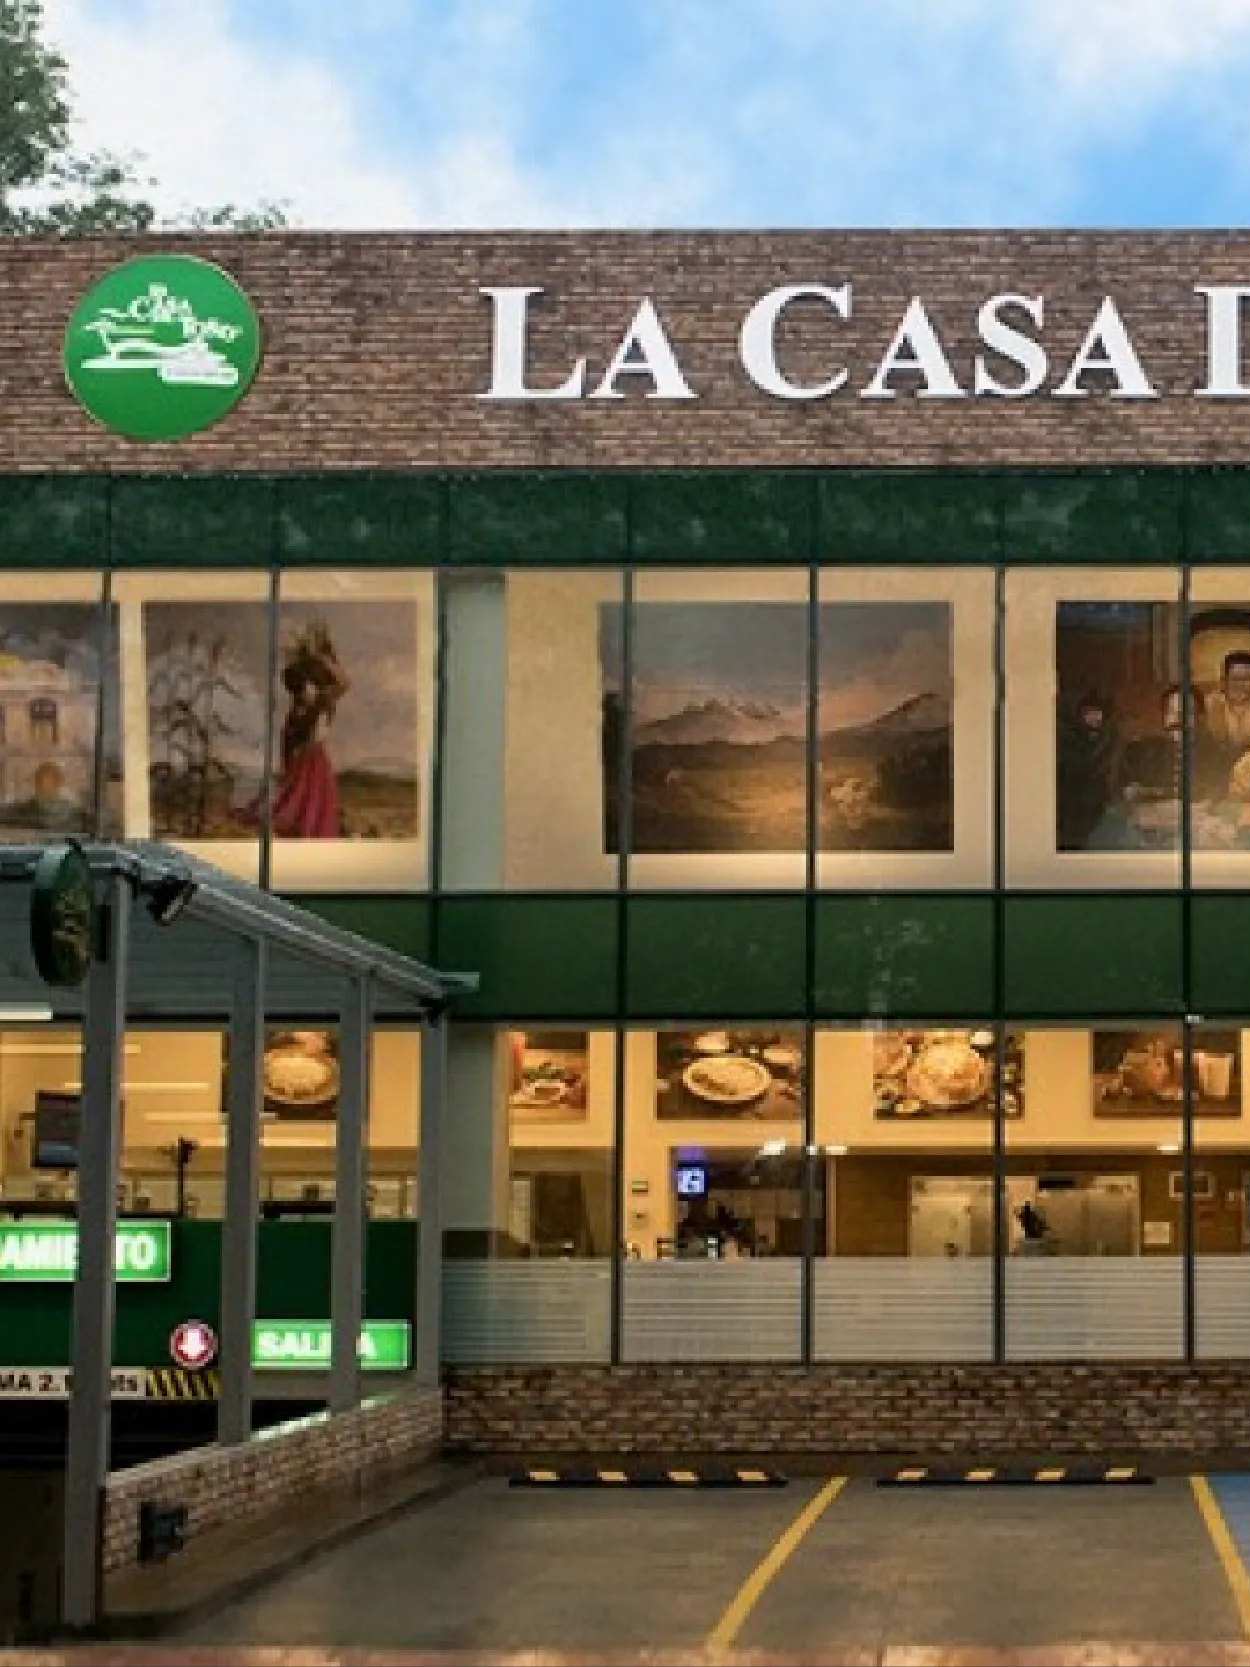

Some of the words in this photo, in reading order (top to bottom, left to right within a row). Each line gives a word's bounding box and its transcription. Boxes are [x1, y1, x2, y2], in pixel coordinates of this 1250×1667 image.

[475, 285, 697, 400] LA
[738, 282, 1158, 400] CASA
[0, 1232, 159, 1271] AMIETO
[258, 1330, 378, 1359] SALIA
